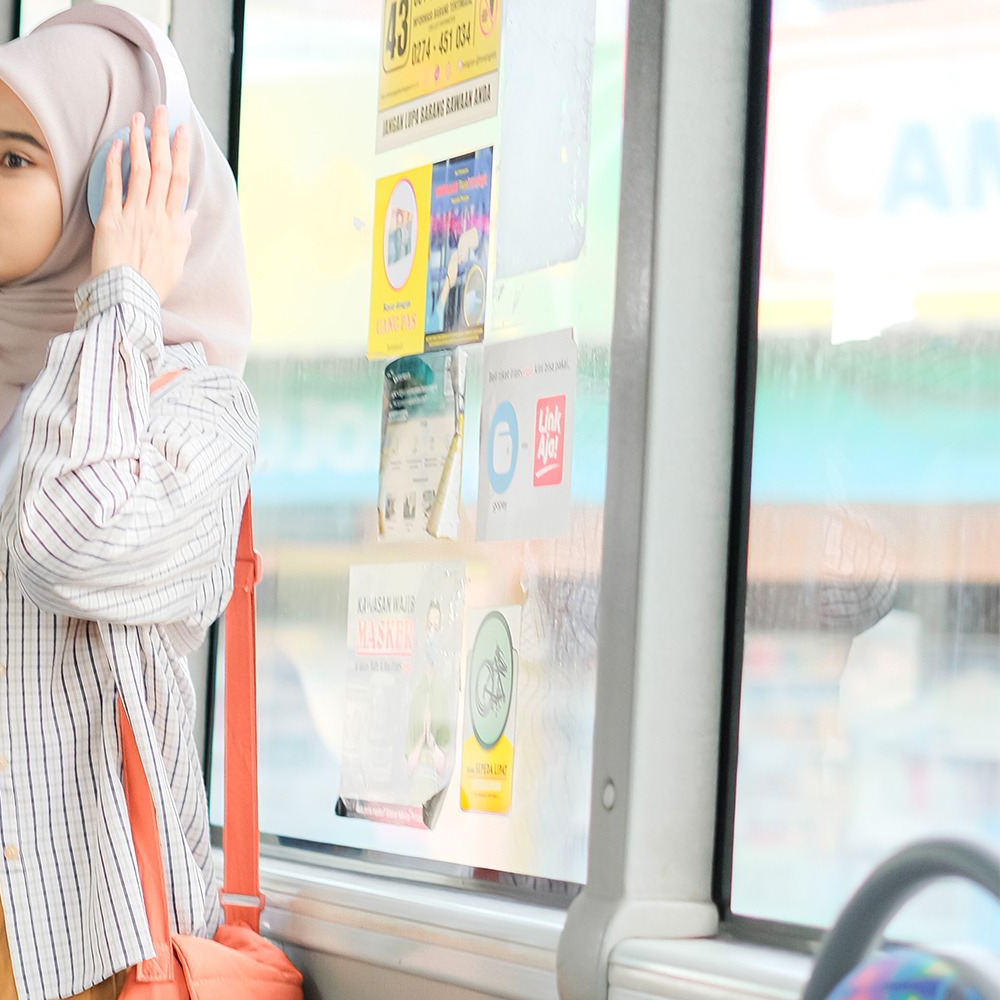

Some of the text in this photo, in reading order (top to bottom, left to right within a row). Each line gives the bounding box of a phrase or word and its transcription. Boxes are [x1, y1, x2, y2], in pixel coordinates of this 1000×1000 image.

[386, 0, 409, 59] 43
[411, 37, 431, 66] 0274
[439, 28, 453, 55] 451
[455, 21, 471, 49] 034
[404, 107, 420, 129] LUPA
[420, 98, 446, 123] BARANG
[445, 89, 473, 115] BAWAAN
[473, 83, 492, 105] ANDA
[400, 311, 417, 332] PAS
[539, 404, 562, 434] Link
[537, 431, 559, 465] Aja!
[357, 595, 416, 614] KAWASAN WAJIB
[356, 618, 414, 650] MASKER
